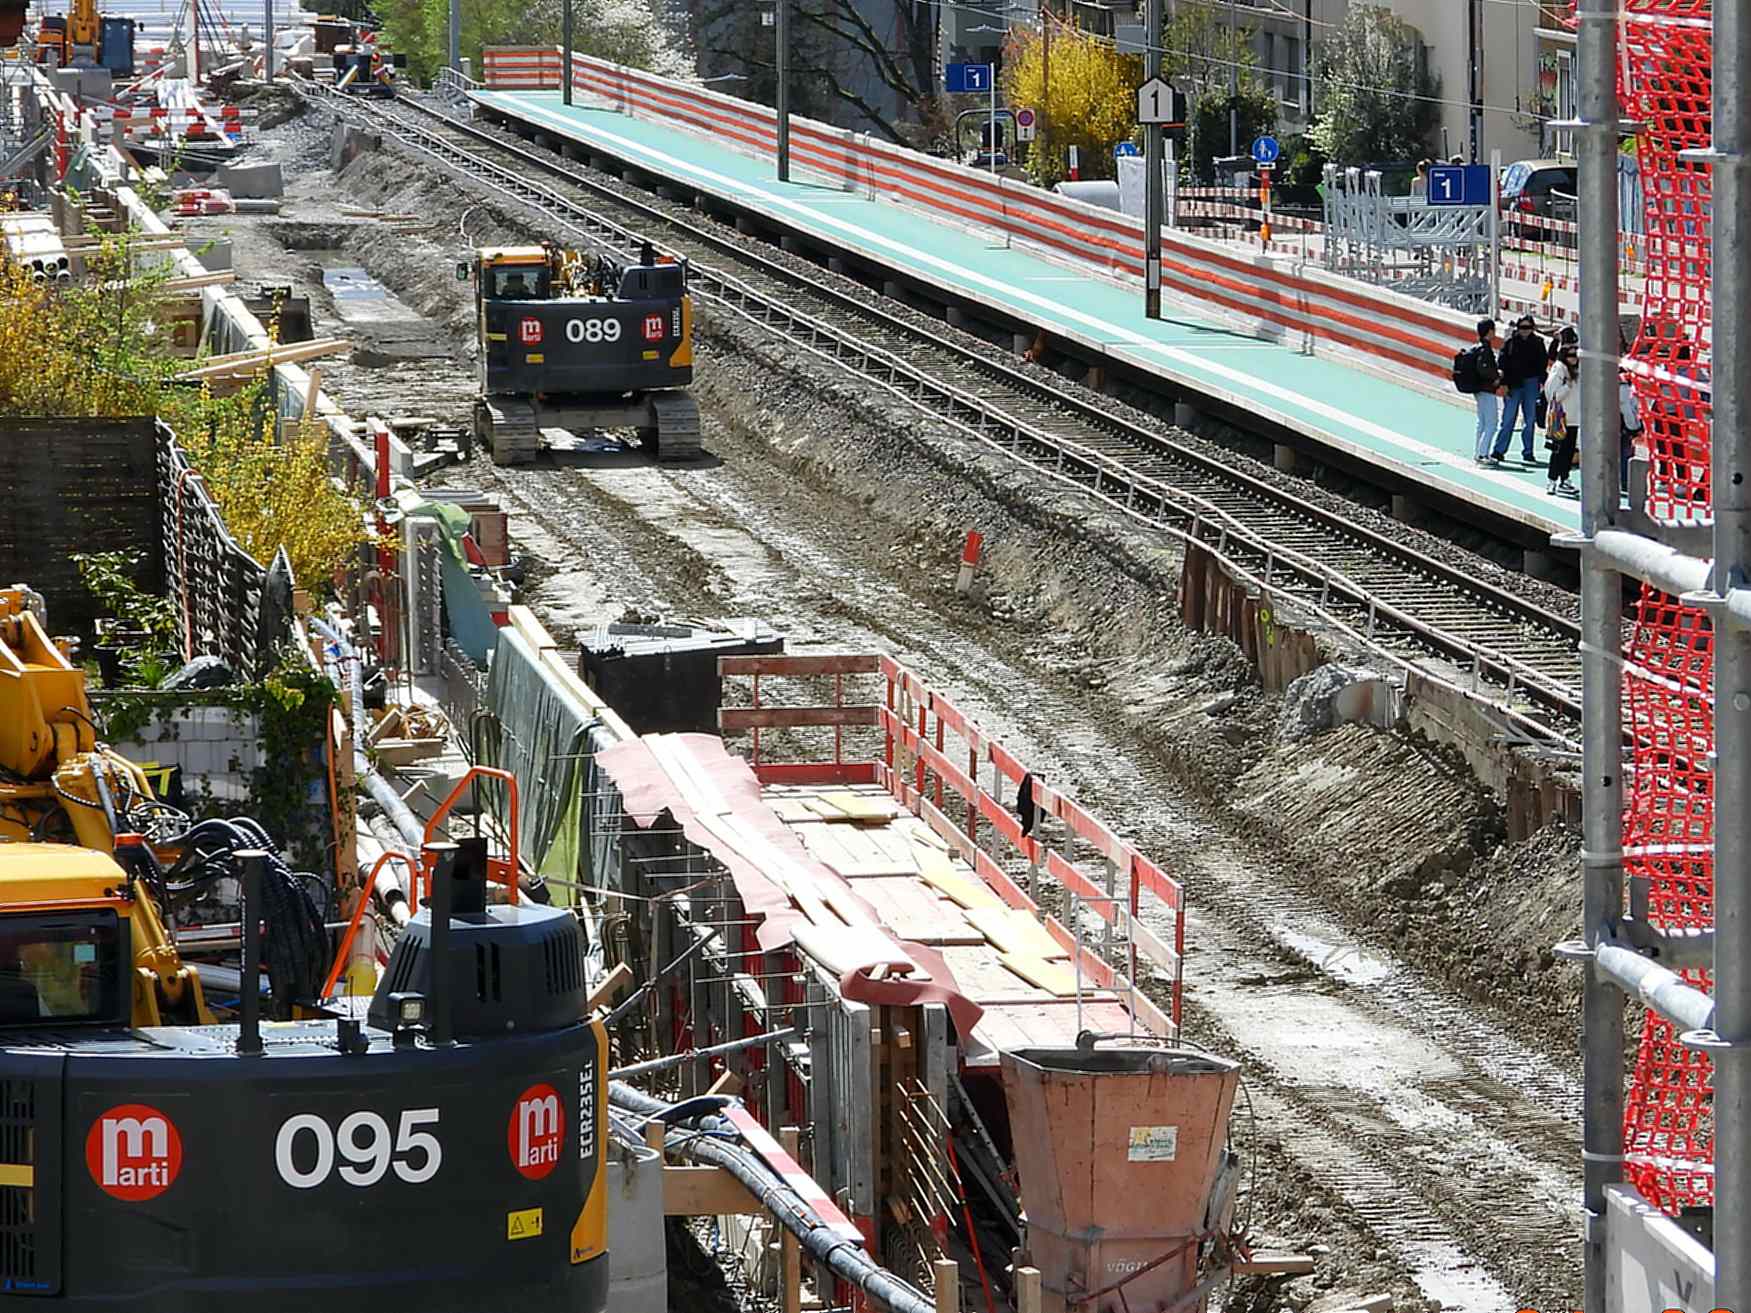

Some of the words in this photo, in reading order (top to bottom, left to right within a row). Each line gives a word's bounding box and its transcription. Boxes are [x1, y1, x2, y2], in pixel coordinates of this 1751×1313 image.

[1151, 89, 1158, 117] 1
[1441, 178, 1450, 198] 1
[566, 318, 621, 342] 089
[276, 1108, 442, 1188] 095
